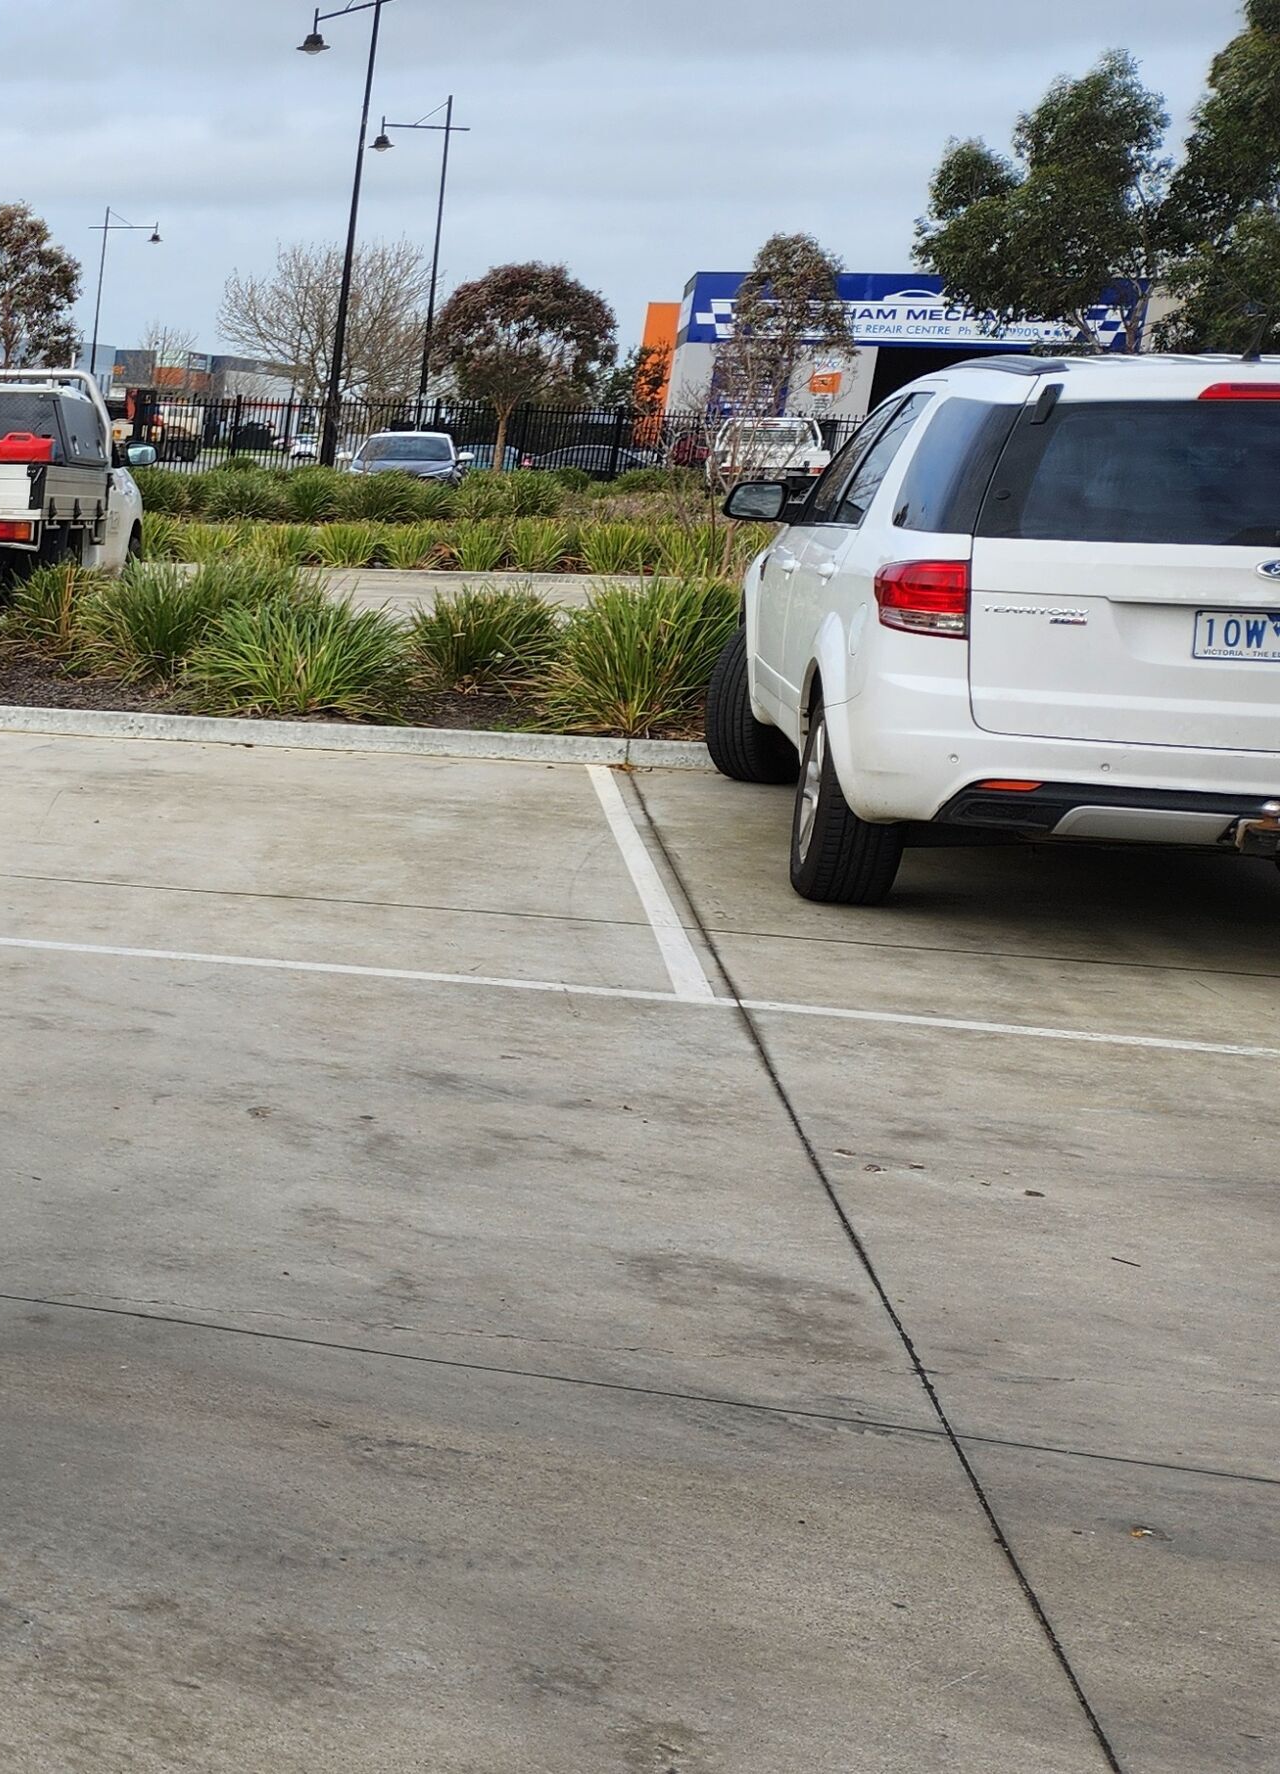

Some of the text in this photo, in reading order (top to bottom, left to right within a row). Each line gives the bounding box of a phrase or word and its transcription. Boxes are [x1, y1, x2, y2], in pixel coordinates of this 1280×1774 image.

[865, 324, 903, 334] REPAIR
[906, 325, 951, 335] CENTRE
[958, 326, 971, 335] Ph
[981, 604, 1089, 616] TERRITORY
